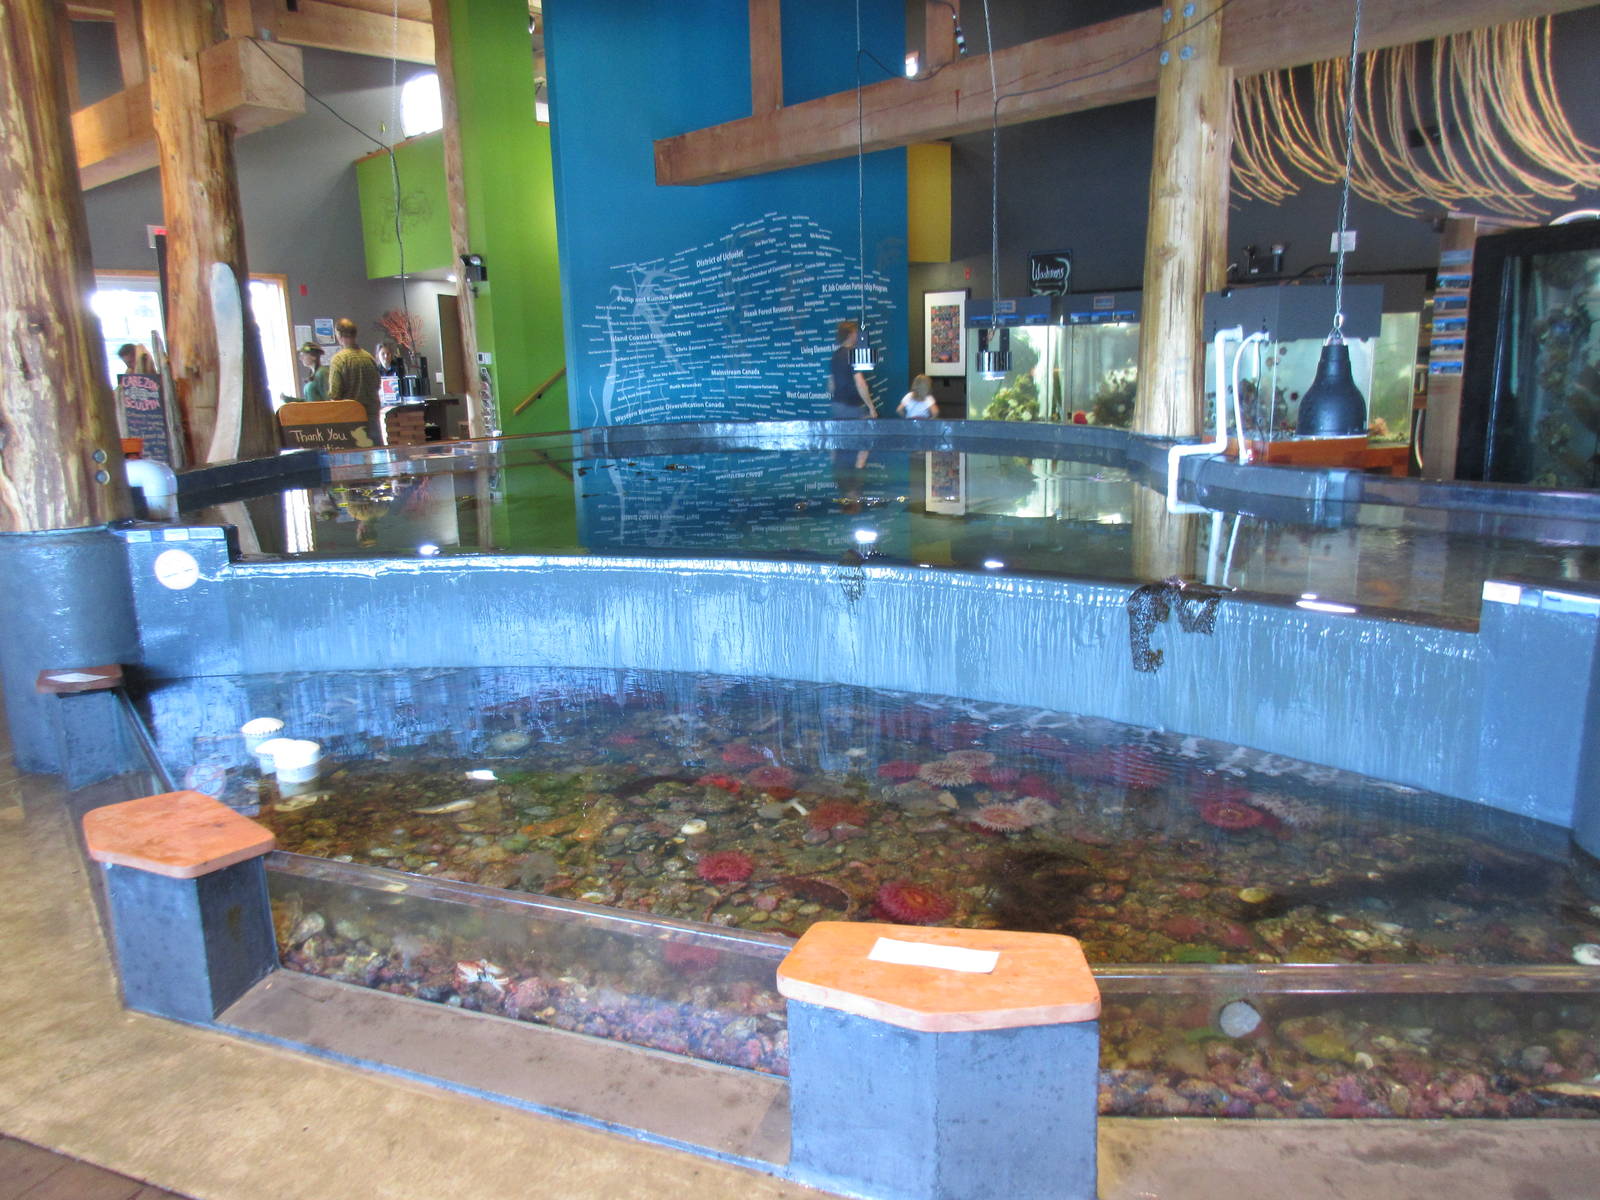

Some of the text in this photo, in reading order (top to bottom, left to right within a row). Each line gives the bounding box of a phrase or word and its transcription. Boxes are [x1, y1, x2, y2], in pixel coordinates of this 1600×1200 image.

[696, 255, 716, 268] District
[723, 249, 744, 262] Ucluelet
[852, 282, 873, 292] Partnrship
[611, 335, 628, 343] Island
[677, 329, 692, 337] Trust
[741, 368, 760, 376] Canada
[615, 411, 638, 423] Western
[638, 405, 665, 416] Economic
[665, 402, 704, 411] Diversification
[704, 401, 725, 409] Canada
[288, 427, 348, 443] Thank You
